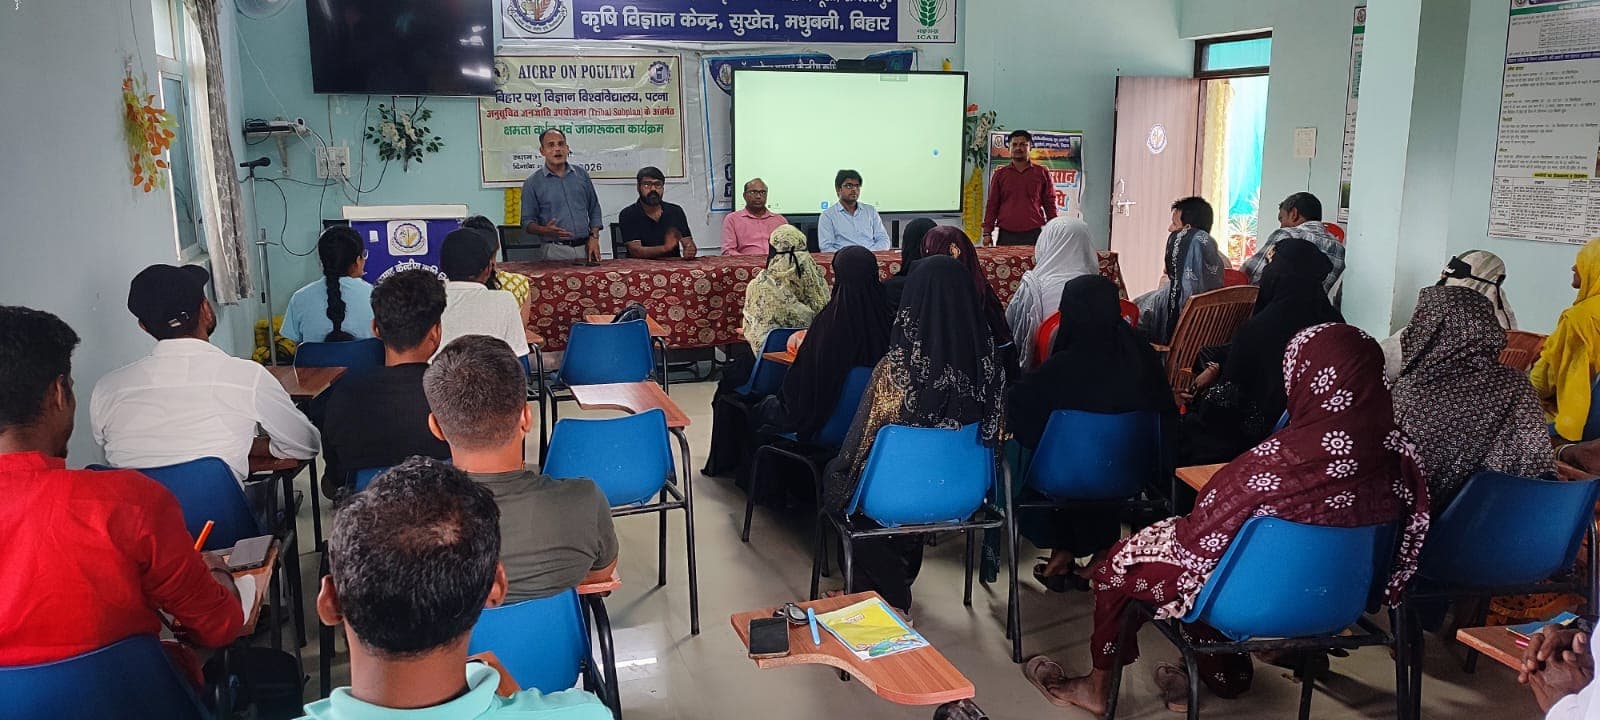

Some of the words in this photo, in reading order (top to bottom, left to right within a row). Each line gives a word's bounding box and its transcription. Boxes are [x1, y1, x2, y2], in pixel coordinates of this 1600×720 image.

[581, 5, 618, 33] कृषि
[622, 6, 676, 30] विज्ञान
[680, 8, 723, 31] केन्द्र,
[729, 9, 779, 35] सुखेत,
[784, 10, 844, 37] मधुबनी,
[850, 10, 891, 31] बिहार
[518, 64, 556, 79] AICRP
[560, 64, 577, 79] ON
[581, 64, 636, 79] POULTRY
[524, 92, 542, 107] पशु
[544, 89, 576, 104] विज्ञान
[644, 92, 669, 102] पटना
[503, 124, 531, 136] क्षमता
[627, 120, 664, 136] कार्यक्रम
